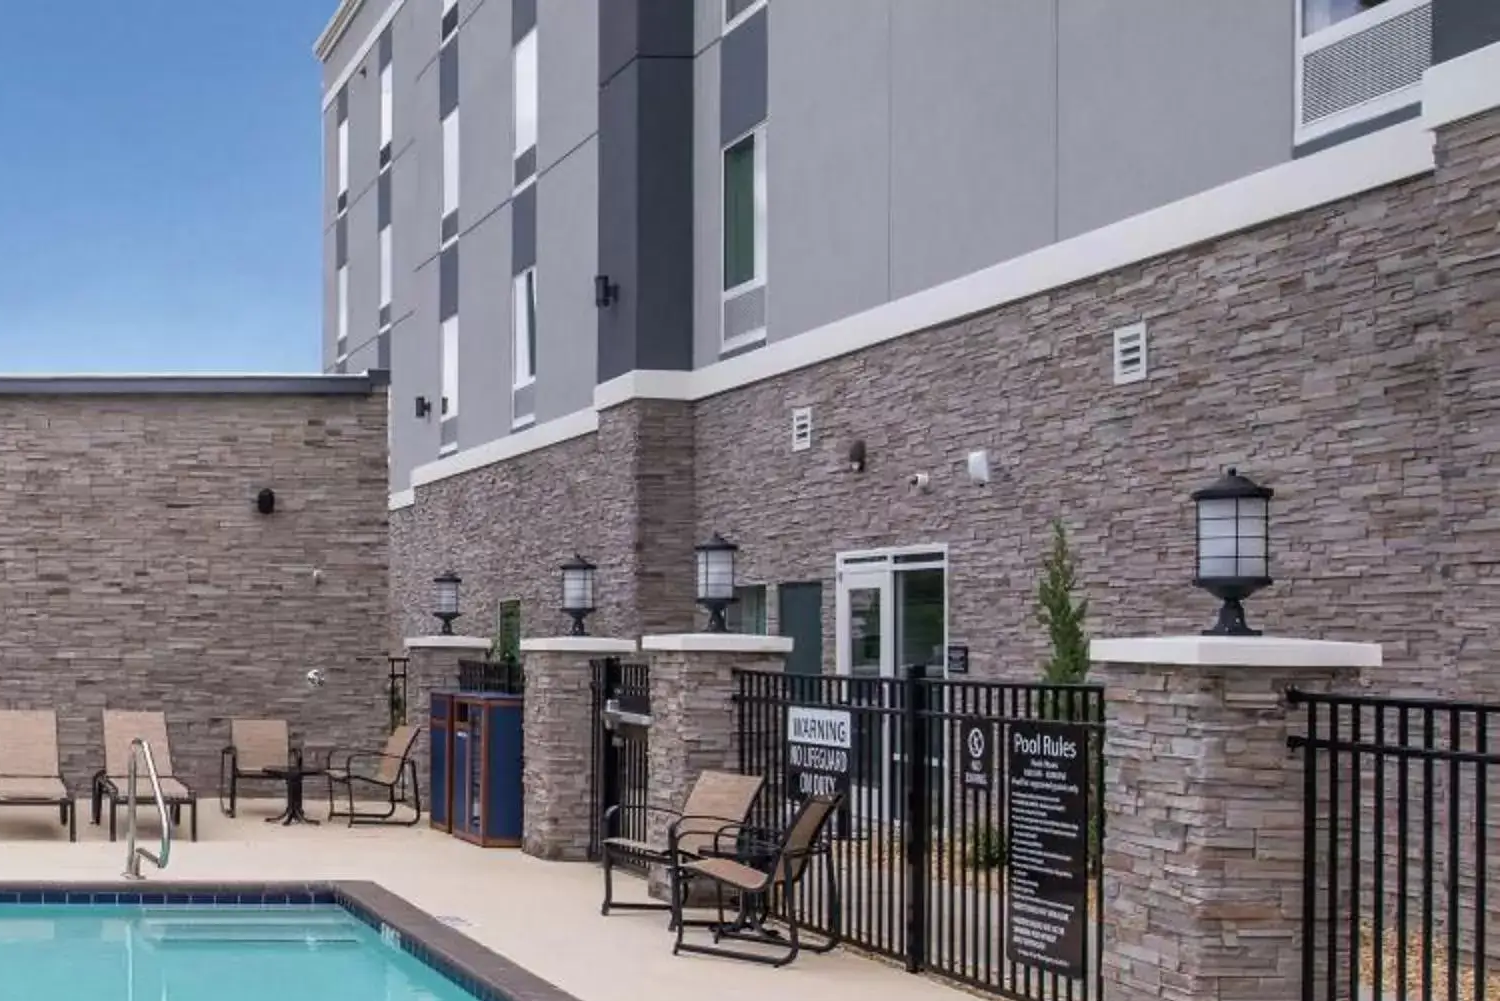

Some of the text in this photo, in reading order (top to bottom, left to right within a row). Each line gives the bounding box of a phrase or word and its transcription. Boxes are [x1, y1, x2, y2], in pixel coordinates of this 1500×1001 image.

[793, 718, 846, 742] WARNING
[1013, 732, 1077, 758] Pool Rules
[789, 744, 849, 773] NO LIFEGUARD
[800, 772, 837, 796] ON DUTY
